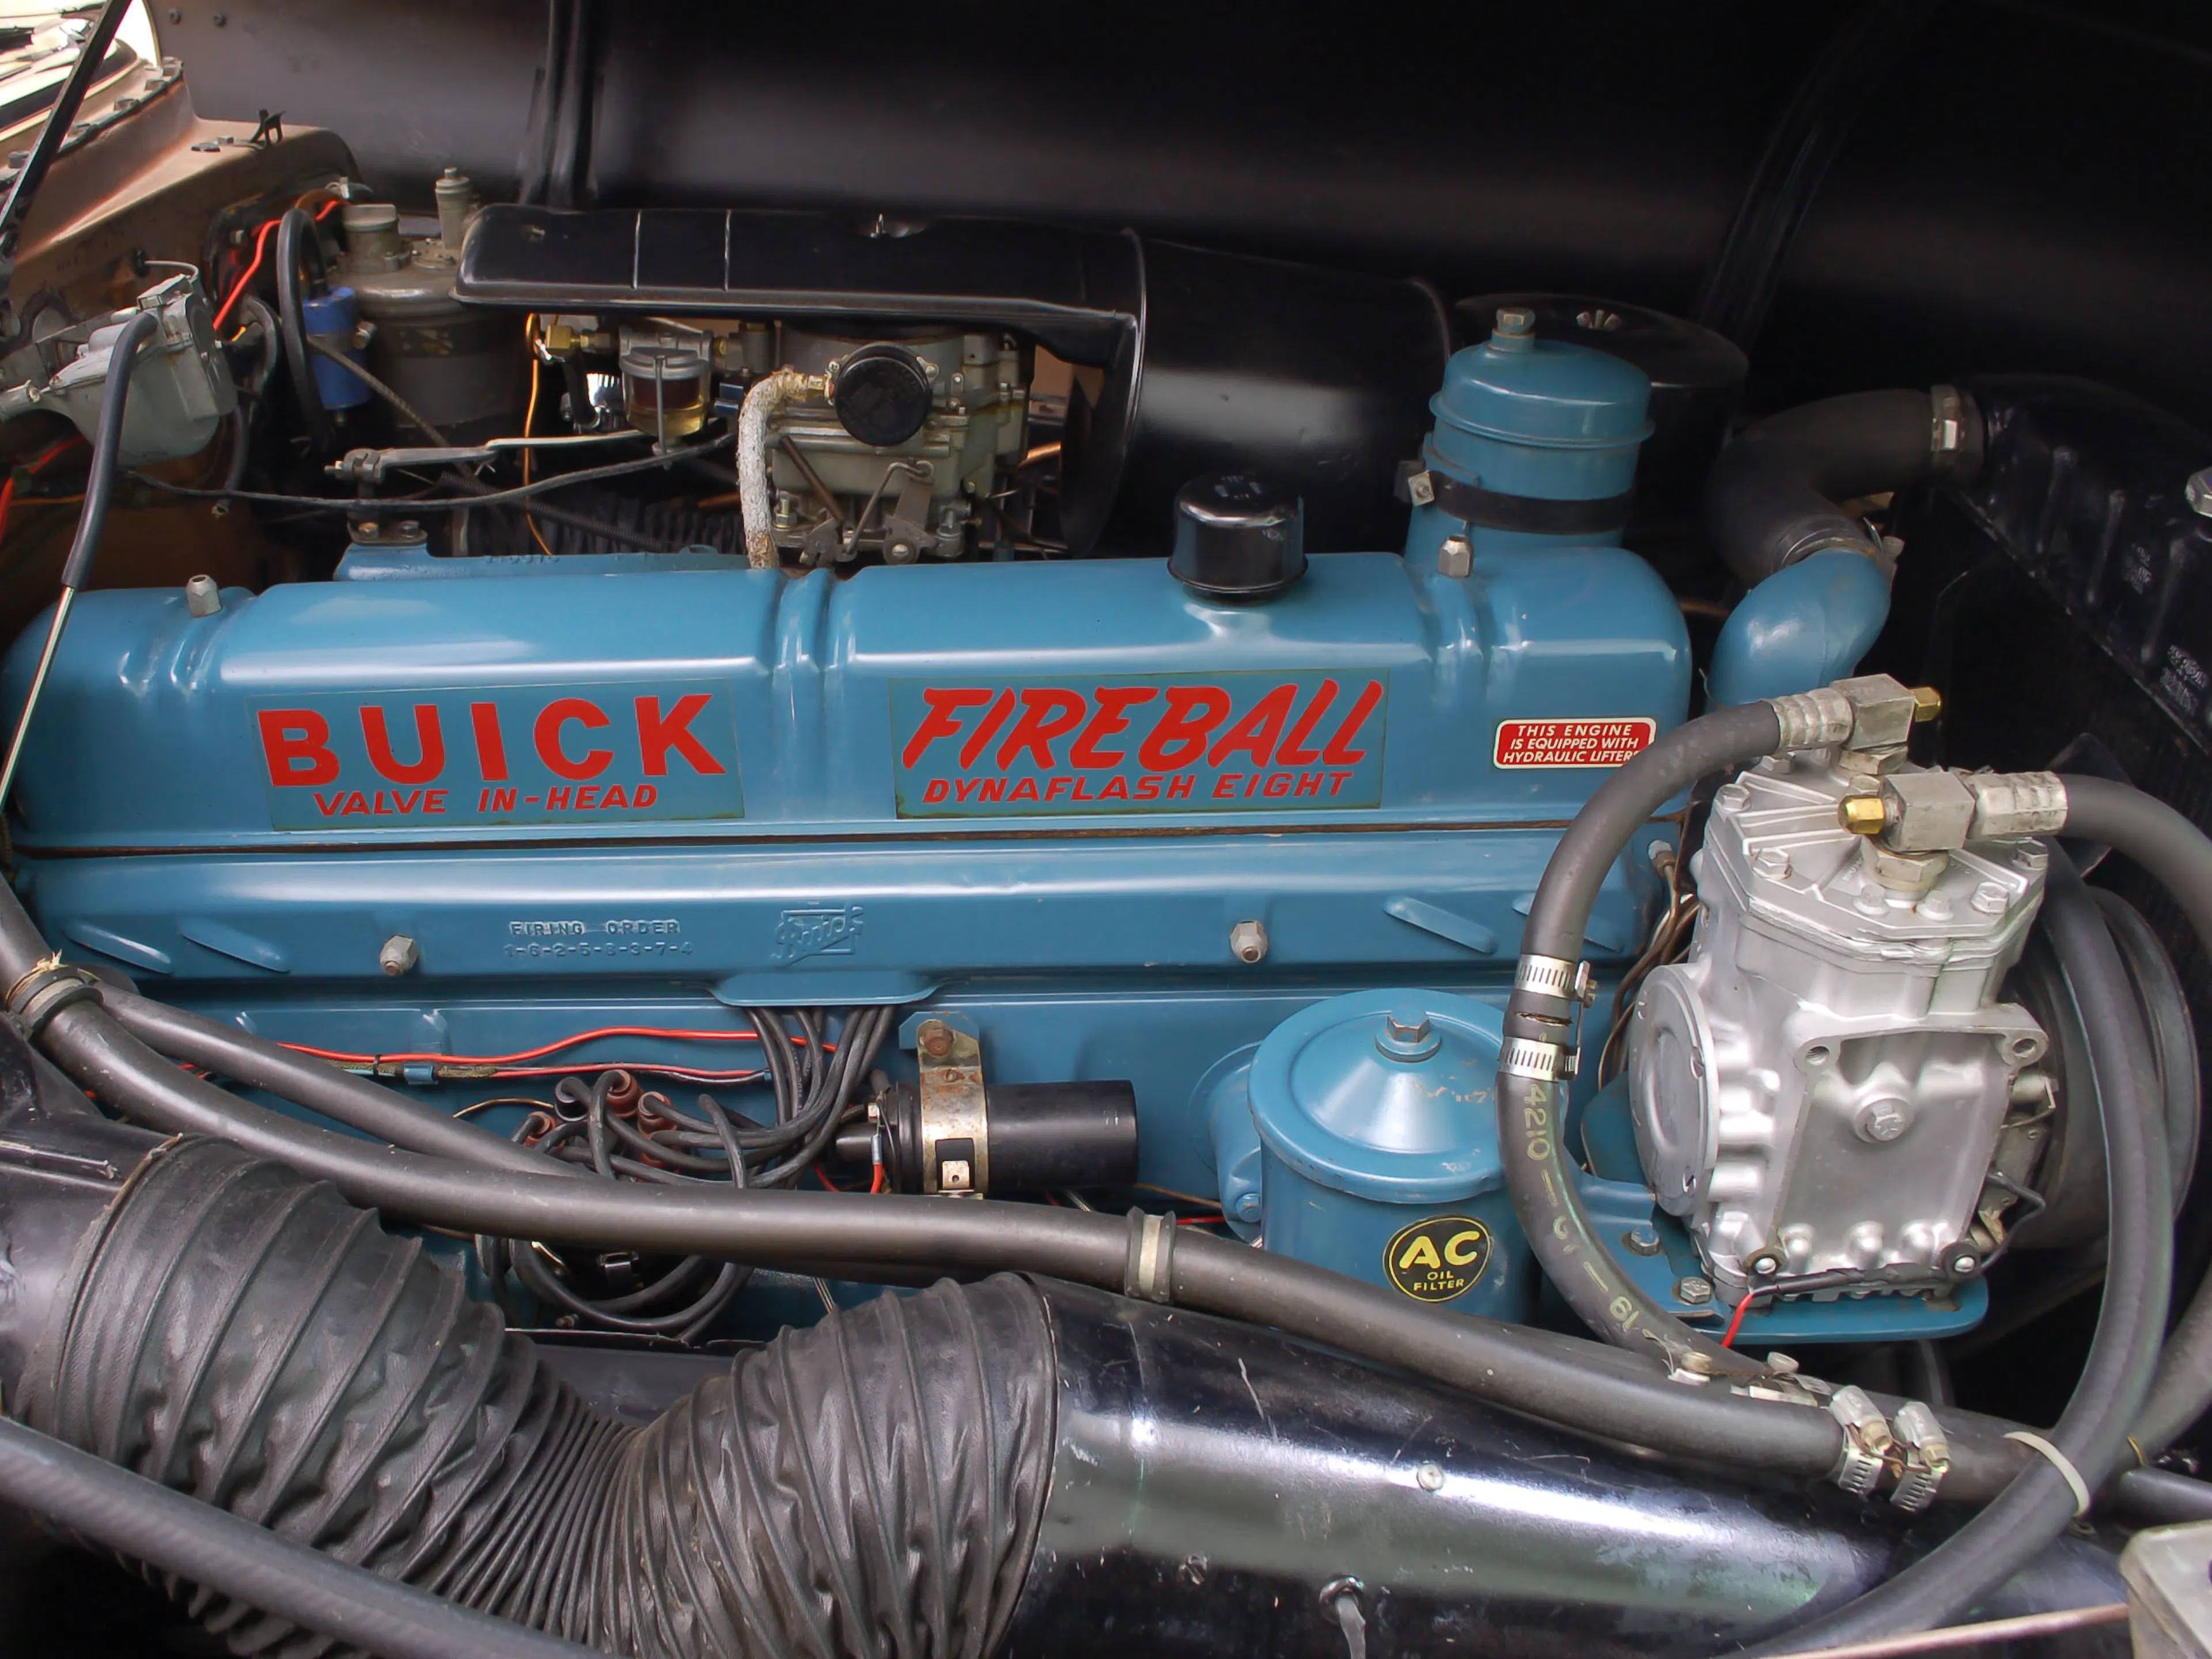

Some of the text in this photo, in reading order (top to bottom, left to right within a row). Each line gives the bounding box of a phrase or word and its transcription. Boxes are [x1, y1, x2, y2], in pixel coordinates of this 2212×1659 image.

[902, 679, 1384, 772] FIREBALL
[1518, 724, 1632, 737] THIS ENGINE
[257, 694, 726, 787] BUICK
[1510, 737, 1639, 749] IS EQUIPPED WITH
[1503, 751, 1586, 763] HYDRAULIC
[922, 771, 1354, 804] DYNAFLASH EIGHT
[312, 784, 658, 817] VALVE IN-HEAD
[509, 919, 680, 935] FIRING ORDER
[1399, 1230, 1480, 1269] AC
[1427, 1270, 1455, 1281] OIL
[1413, 1278, 1464, 1291] FILTER
